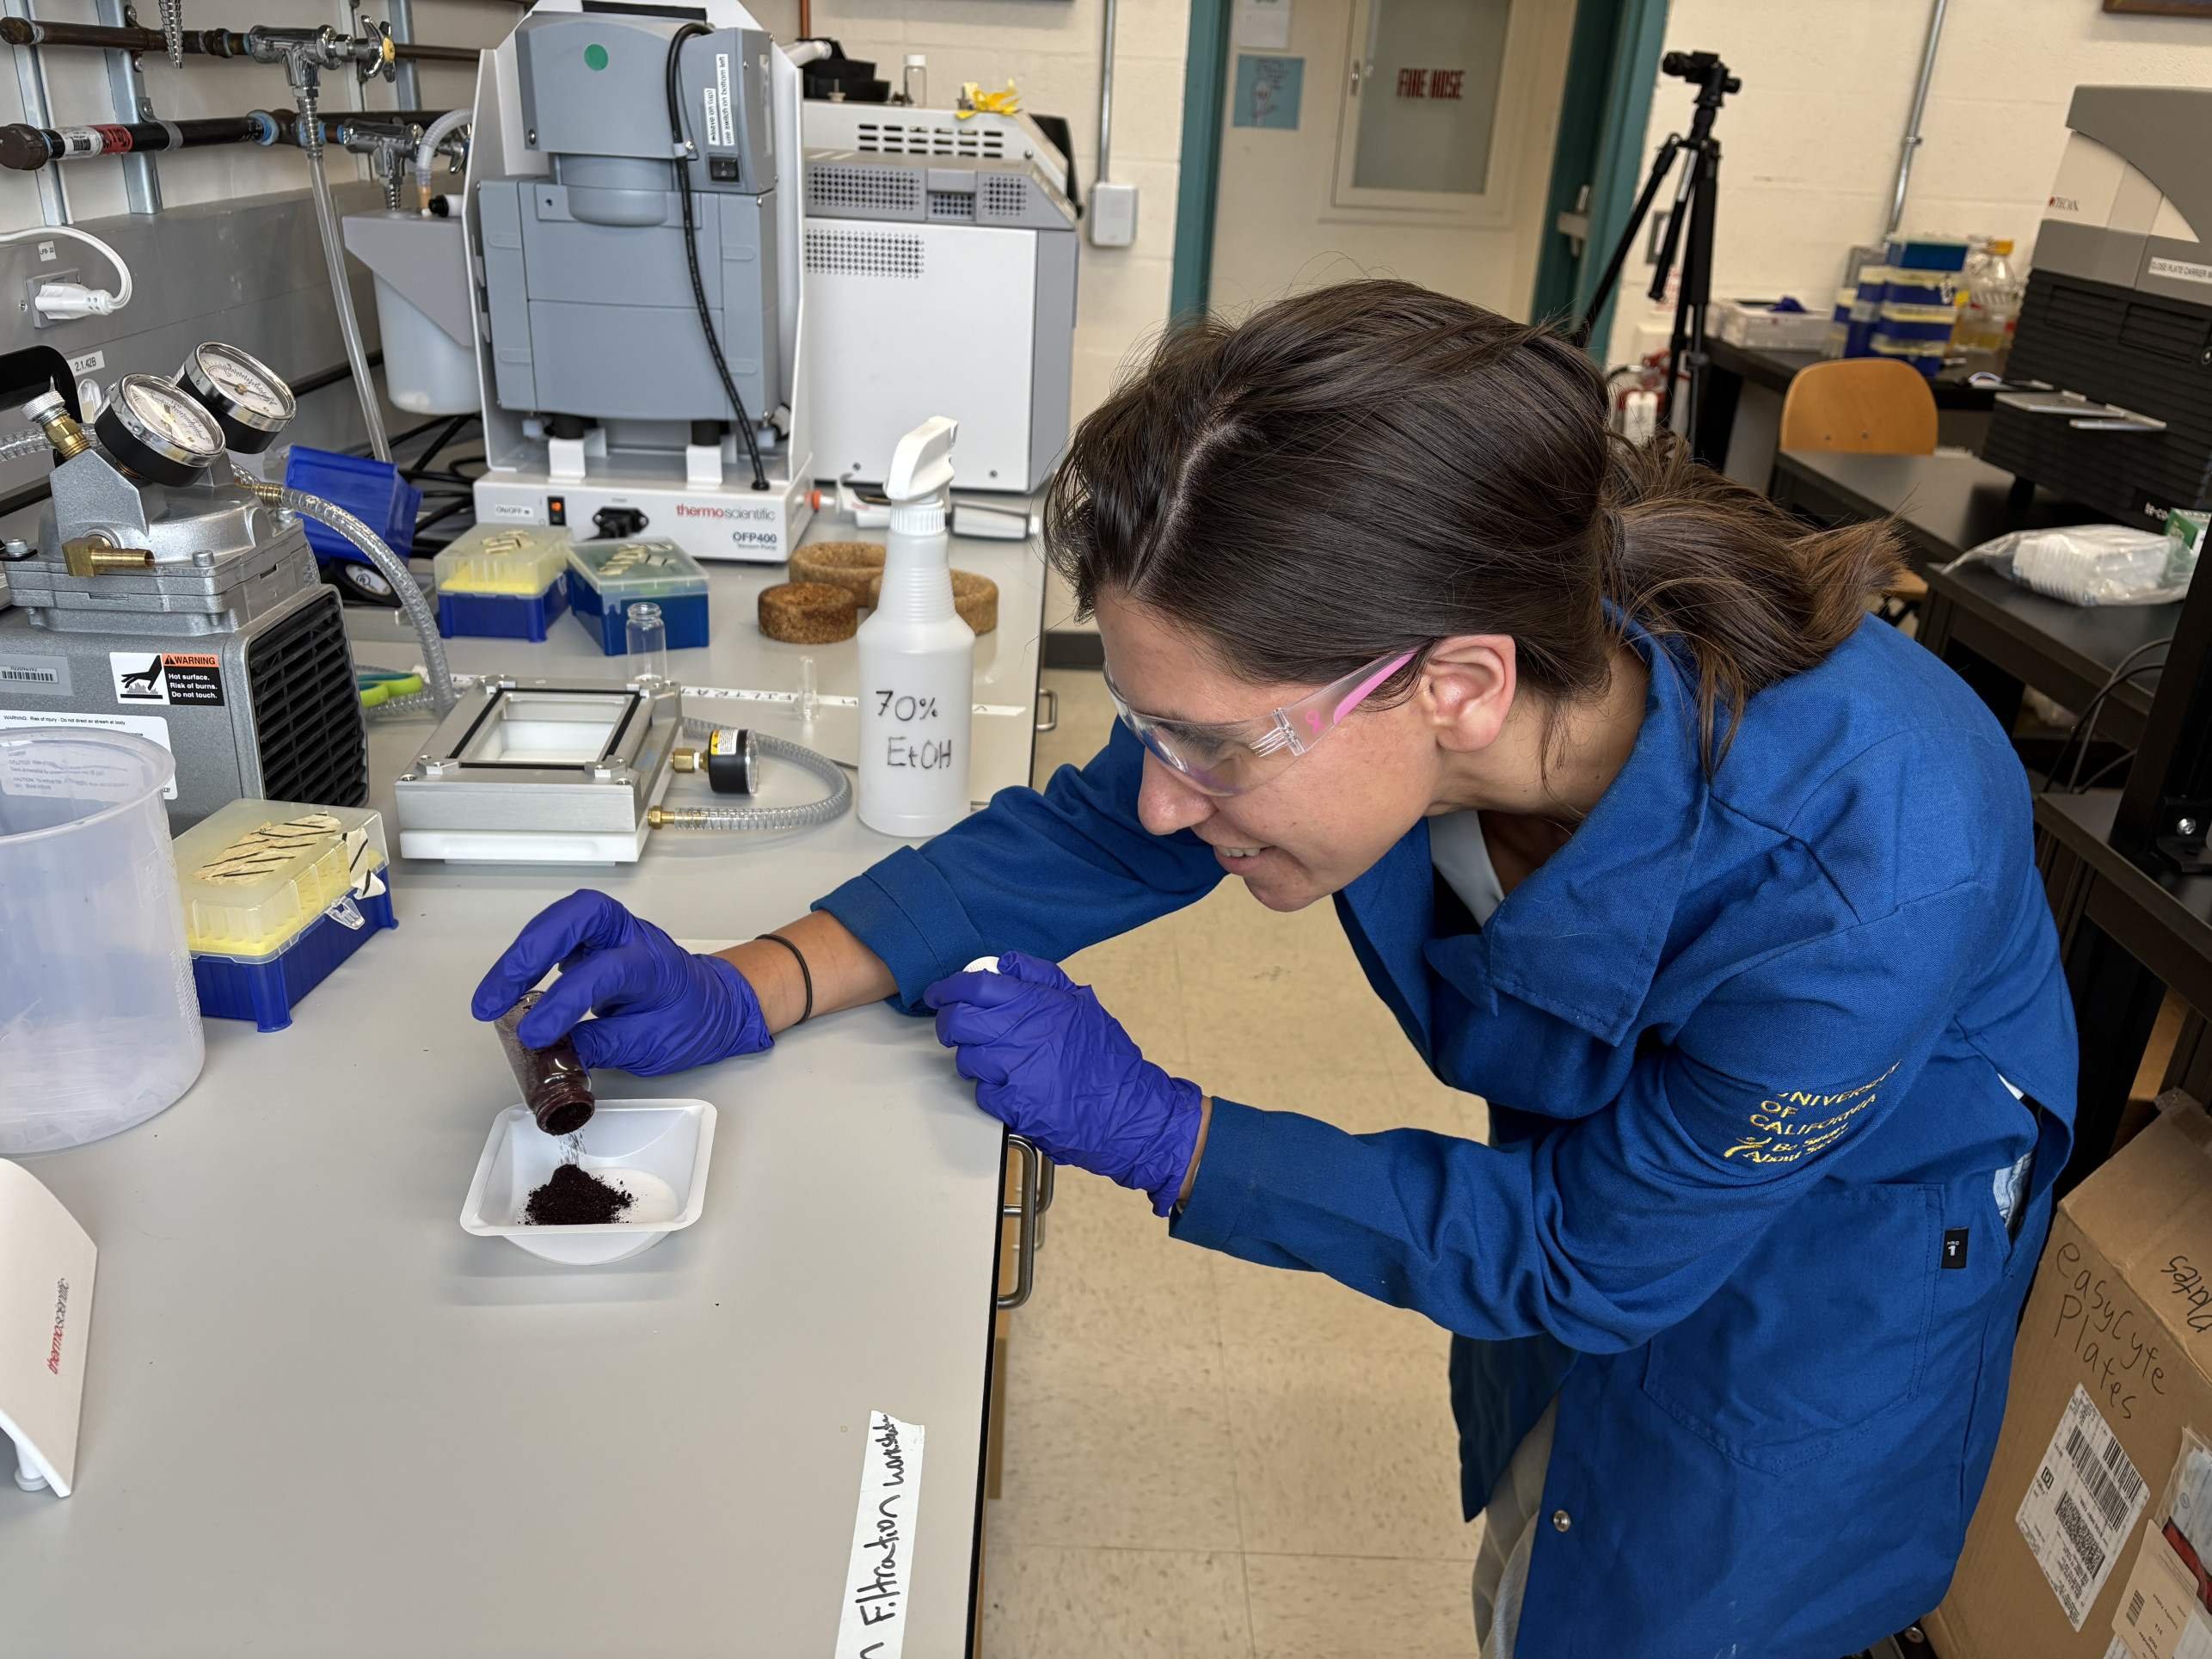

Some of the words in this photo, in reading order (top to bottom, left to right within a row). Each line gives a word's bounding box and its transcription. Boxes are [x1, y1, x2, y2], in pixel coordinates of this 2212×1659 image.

[74, 357, 96, 372] 2.1.42B
[733, 531, 777, 543] OFP400
[175, 656, 216, 665] WARNING
[876, 691, 938, 722] 70%
[887, 736, 952, 769] EtOH
[1778, 1059, 1902, 1107] NIVERSITY
[1749, 1094, 1877, 1135] CALIFORNIA
[1760, 1100, 1798, 1118] OF
[1743, 1151, 1802, 1164] About
[1773, 1143, 1798, 1152] Be
[1948, 1245, 1956, 1256] 1
[46, 1277, 69, 1375] thermoscientific
[2054, 1294, 2137, 1419] Plates
[855, 1494, 900, 1625] Filtration
